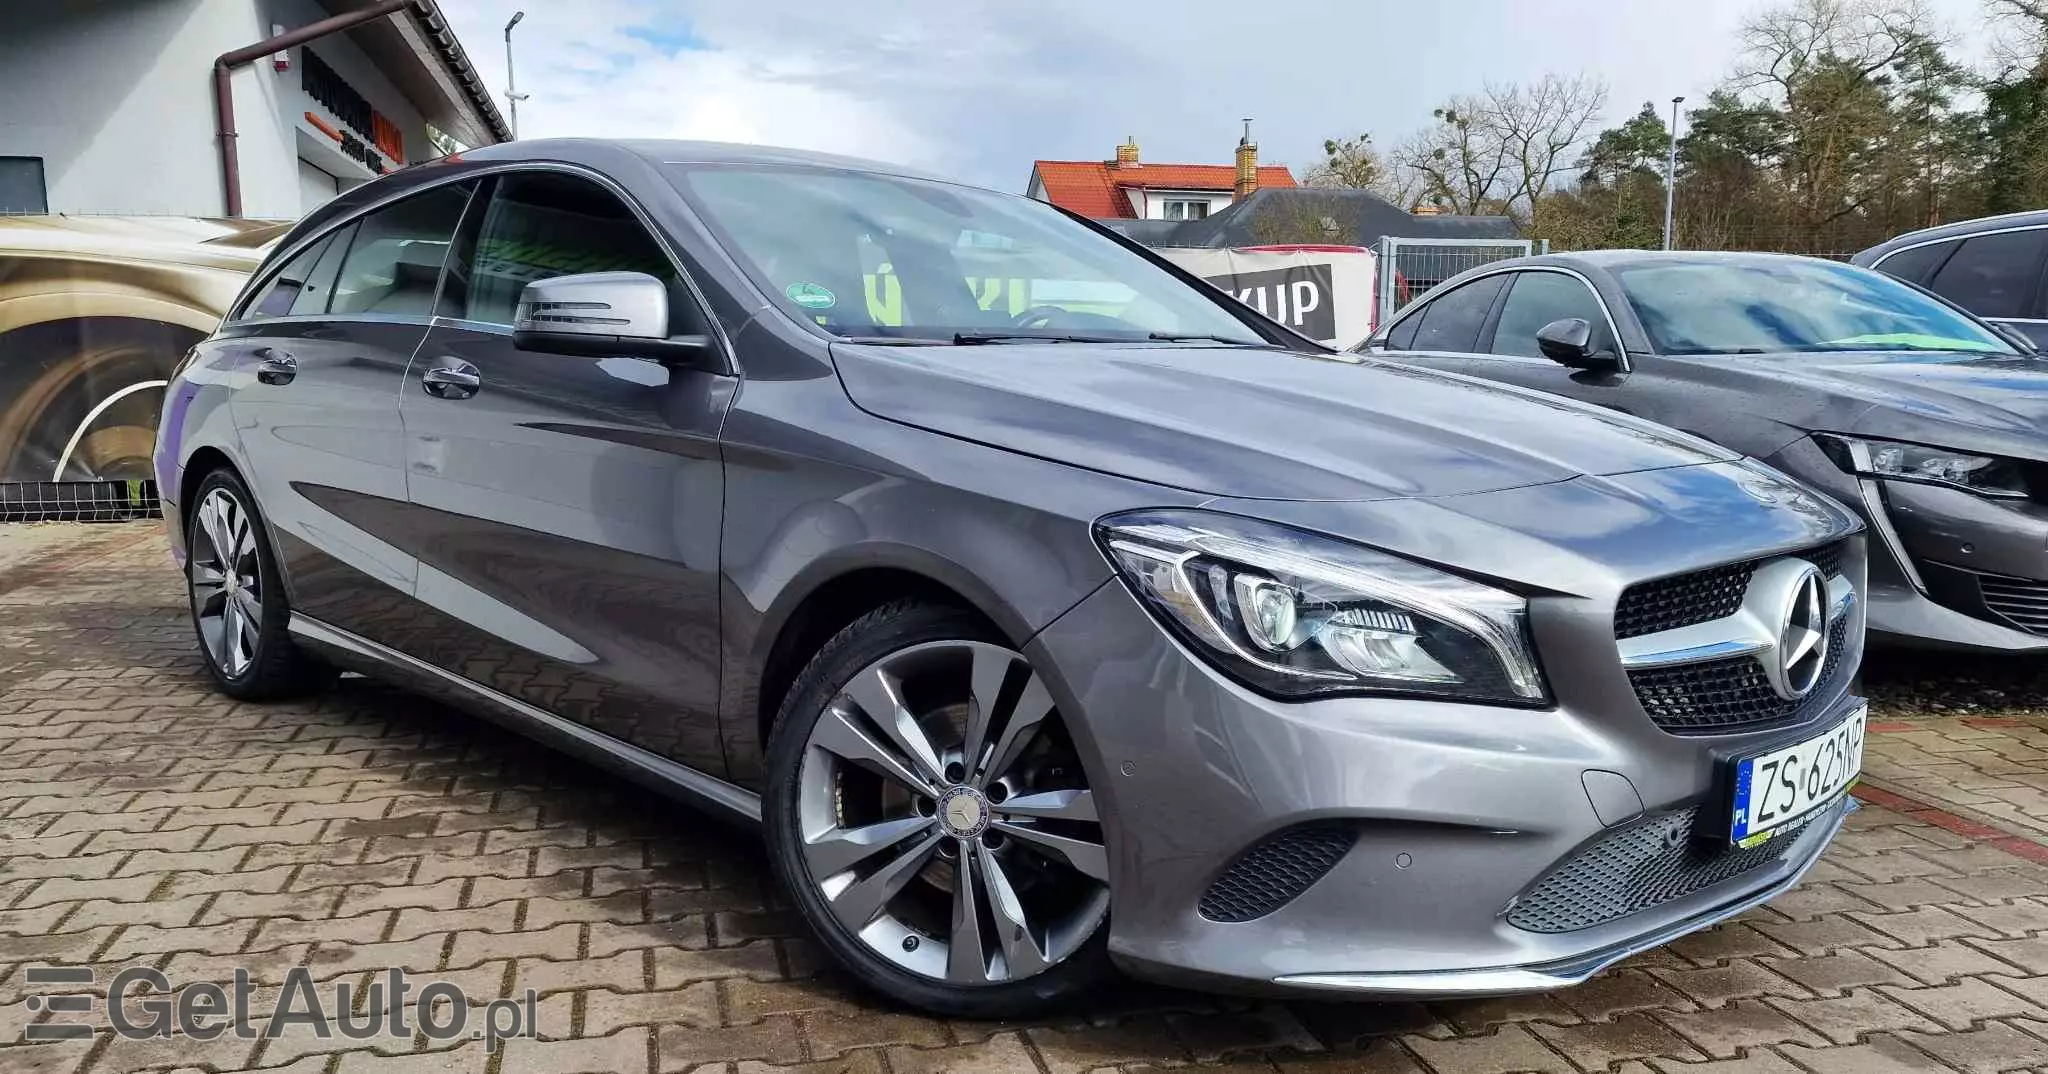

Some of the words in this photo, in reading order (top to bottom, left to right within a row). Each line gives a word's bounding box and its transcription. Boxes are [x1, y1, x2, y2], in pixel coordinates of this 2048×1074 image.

[1757, 754, 1798, 824] ZS
[1807, 717, 1862, 801] 625NP
[1734, 807, 1748, 826] PL
